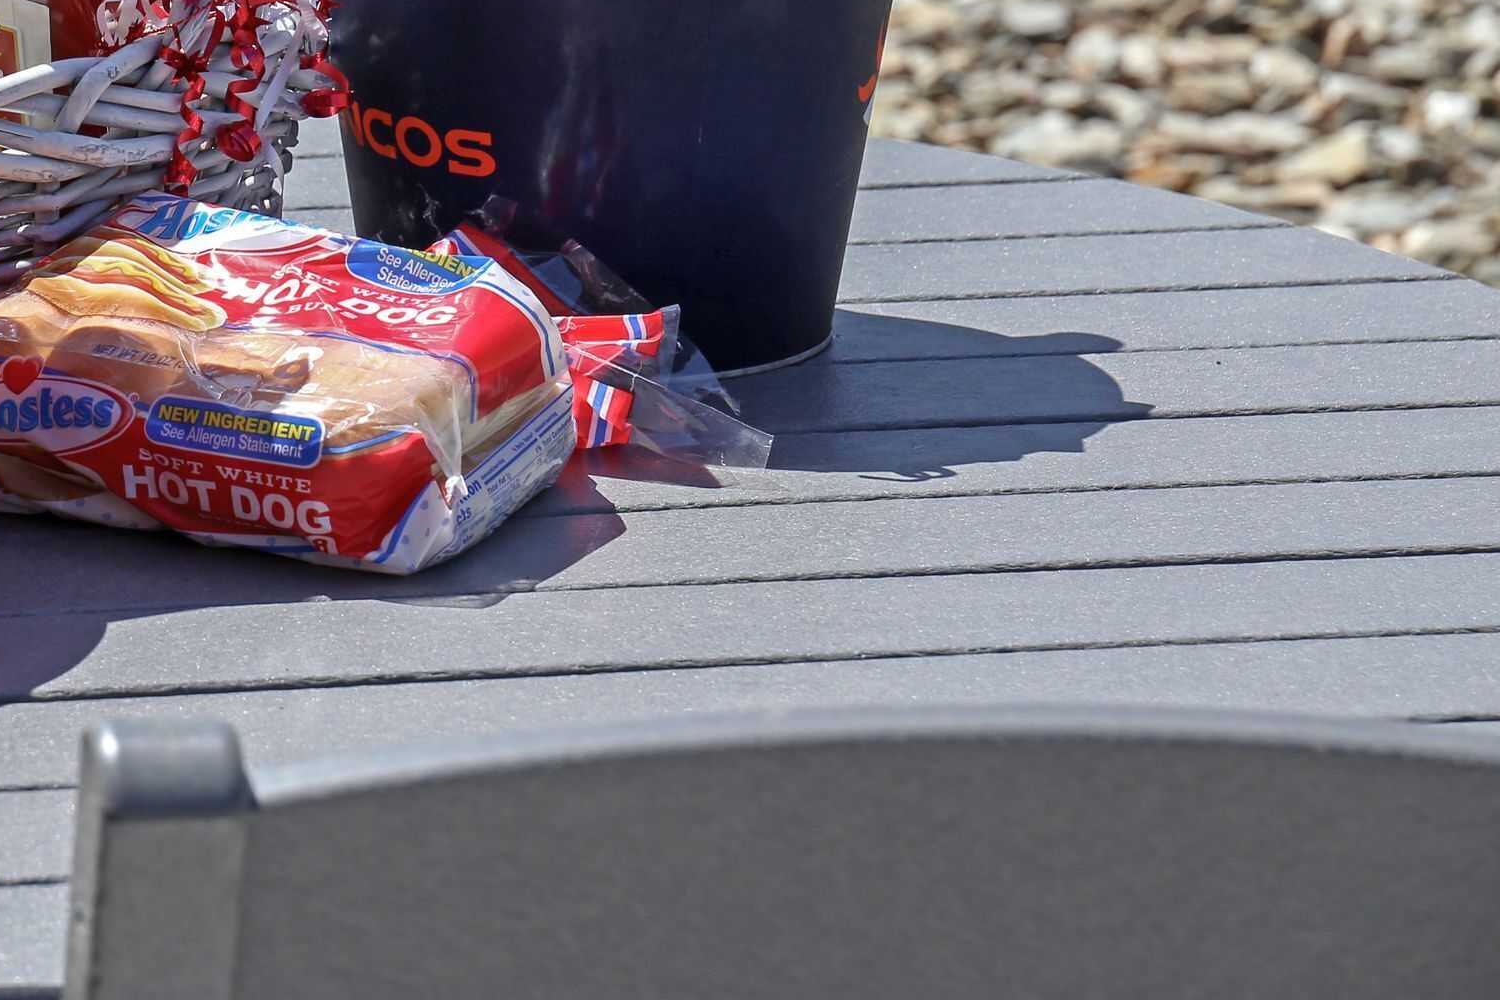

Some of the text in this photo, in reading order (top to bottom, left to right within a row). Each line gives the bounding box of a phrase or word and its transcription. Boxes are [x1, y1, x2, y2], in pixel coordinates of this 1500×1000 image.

[340, 101, 497, 178] NCOS
[377, 247, 401, 269] See
[218, 277, 460, 325] HOT DOG
[92, 343, 118, 356] NET
[120, 347, 138, 361] WT
[141, 352, 156, 365] 12
[157, 355, 175, 369] OZ
[158, 403, 316, 442] NEW INGREDIENT
[160, 422, 304, 459] See Allergen Statement
[138, 446, 312, 494] SOFT WHITE
[122, 464, 332, 535] HOT DOG
